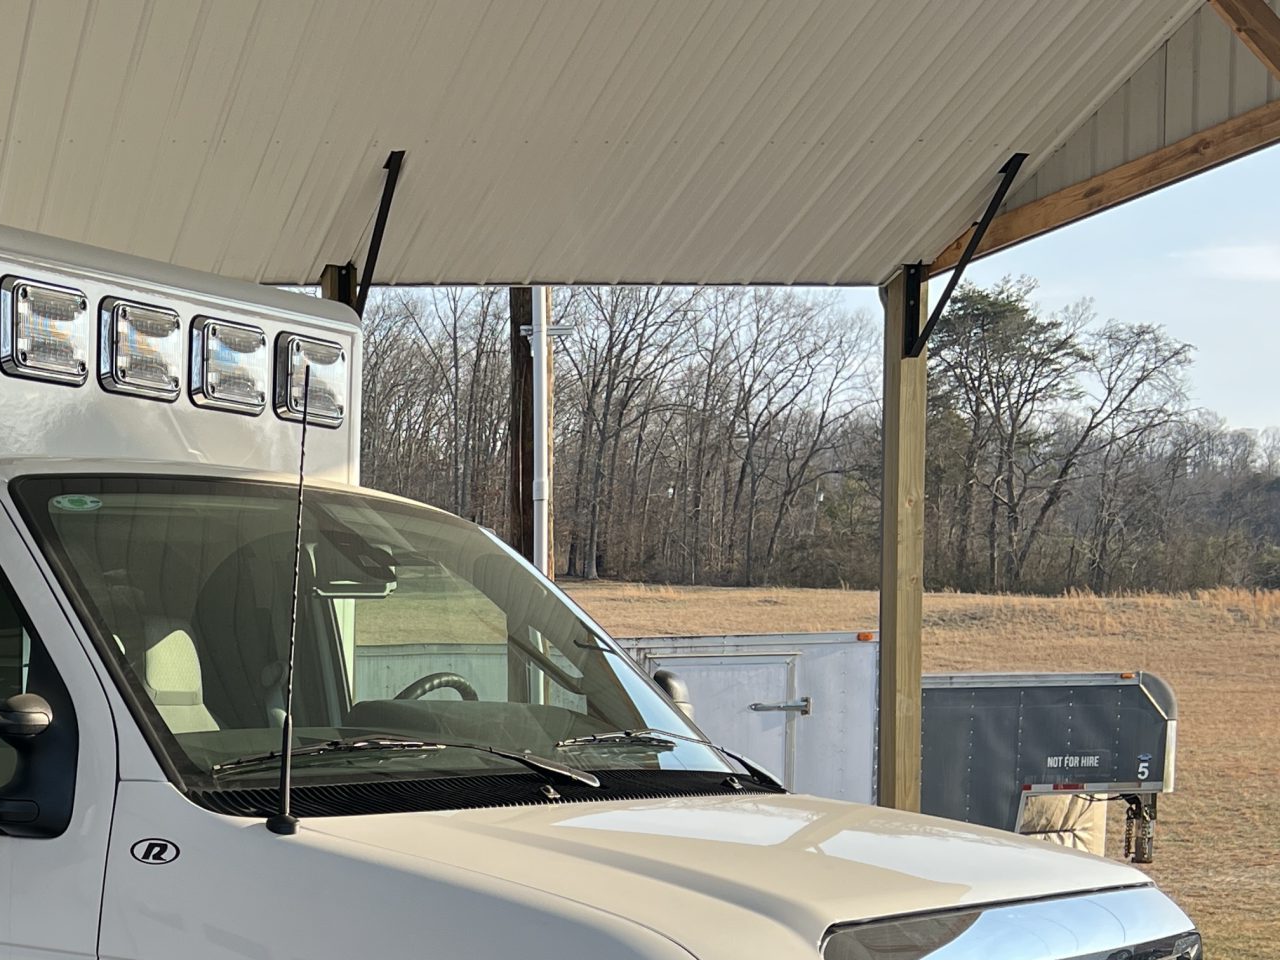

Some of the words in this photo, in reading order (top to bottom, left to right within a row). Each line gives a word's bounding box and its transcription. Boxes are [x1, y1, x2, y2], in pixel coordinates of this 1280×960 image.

[1047, 757, 1065, 768] NOT
[1064, 756, 1079, 767] FOR
[1081, 756, 1100, 767] HIRE
[1137, 762, 1150, 780] 5
[140, 842, 168, 862] R
